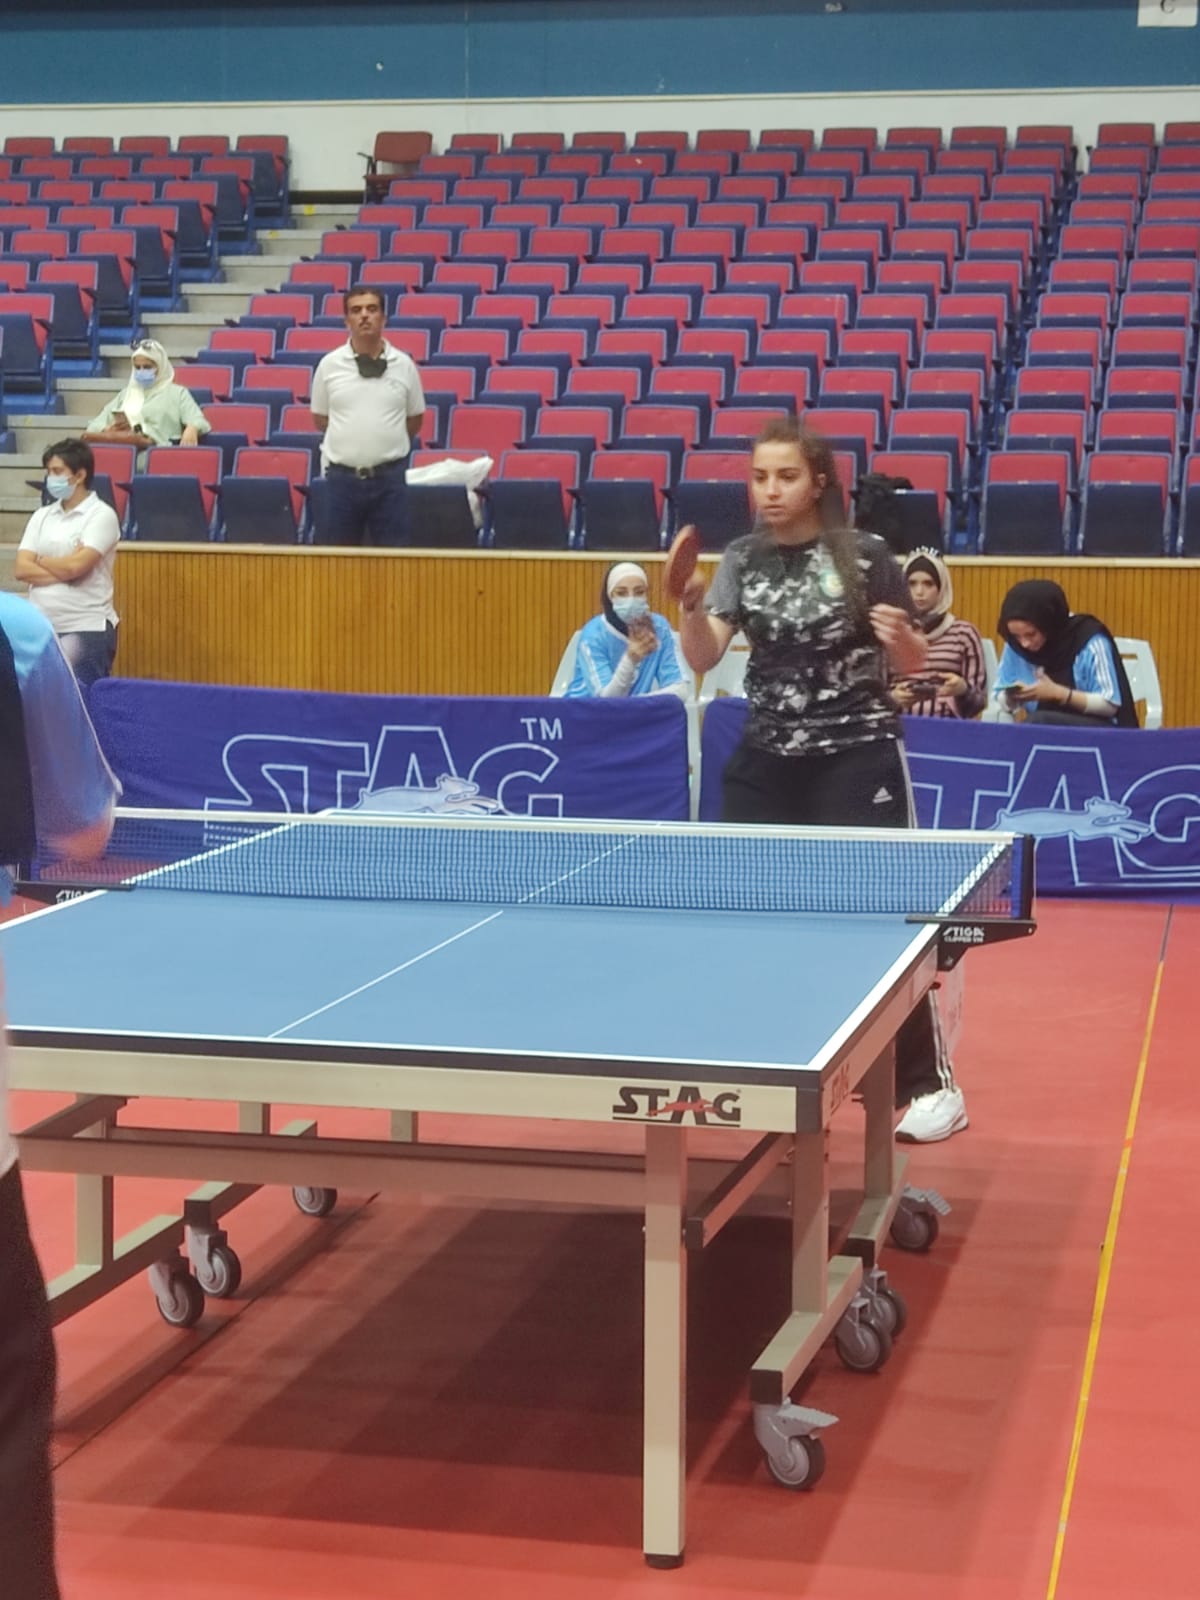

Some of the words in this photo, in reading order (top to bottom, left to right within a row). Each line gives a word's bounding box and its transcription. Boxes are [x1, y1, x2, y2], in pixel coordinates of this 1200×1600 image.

[520, 717, 563, 740] TM
[204, 725, 563, 822] STAG
[906, 744, 1200, 887] TAG
[943, 926, 984, 936] STIGA
[612, 1086, 741, 1125] STAG
